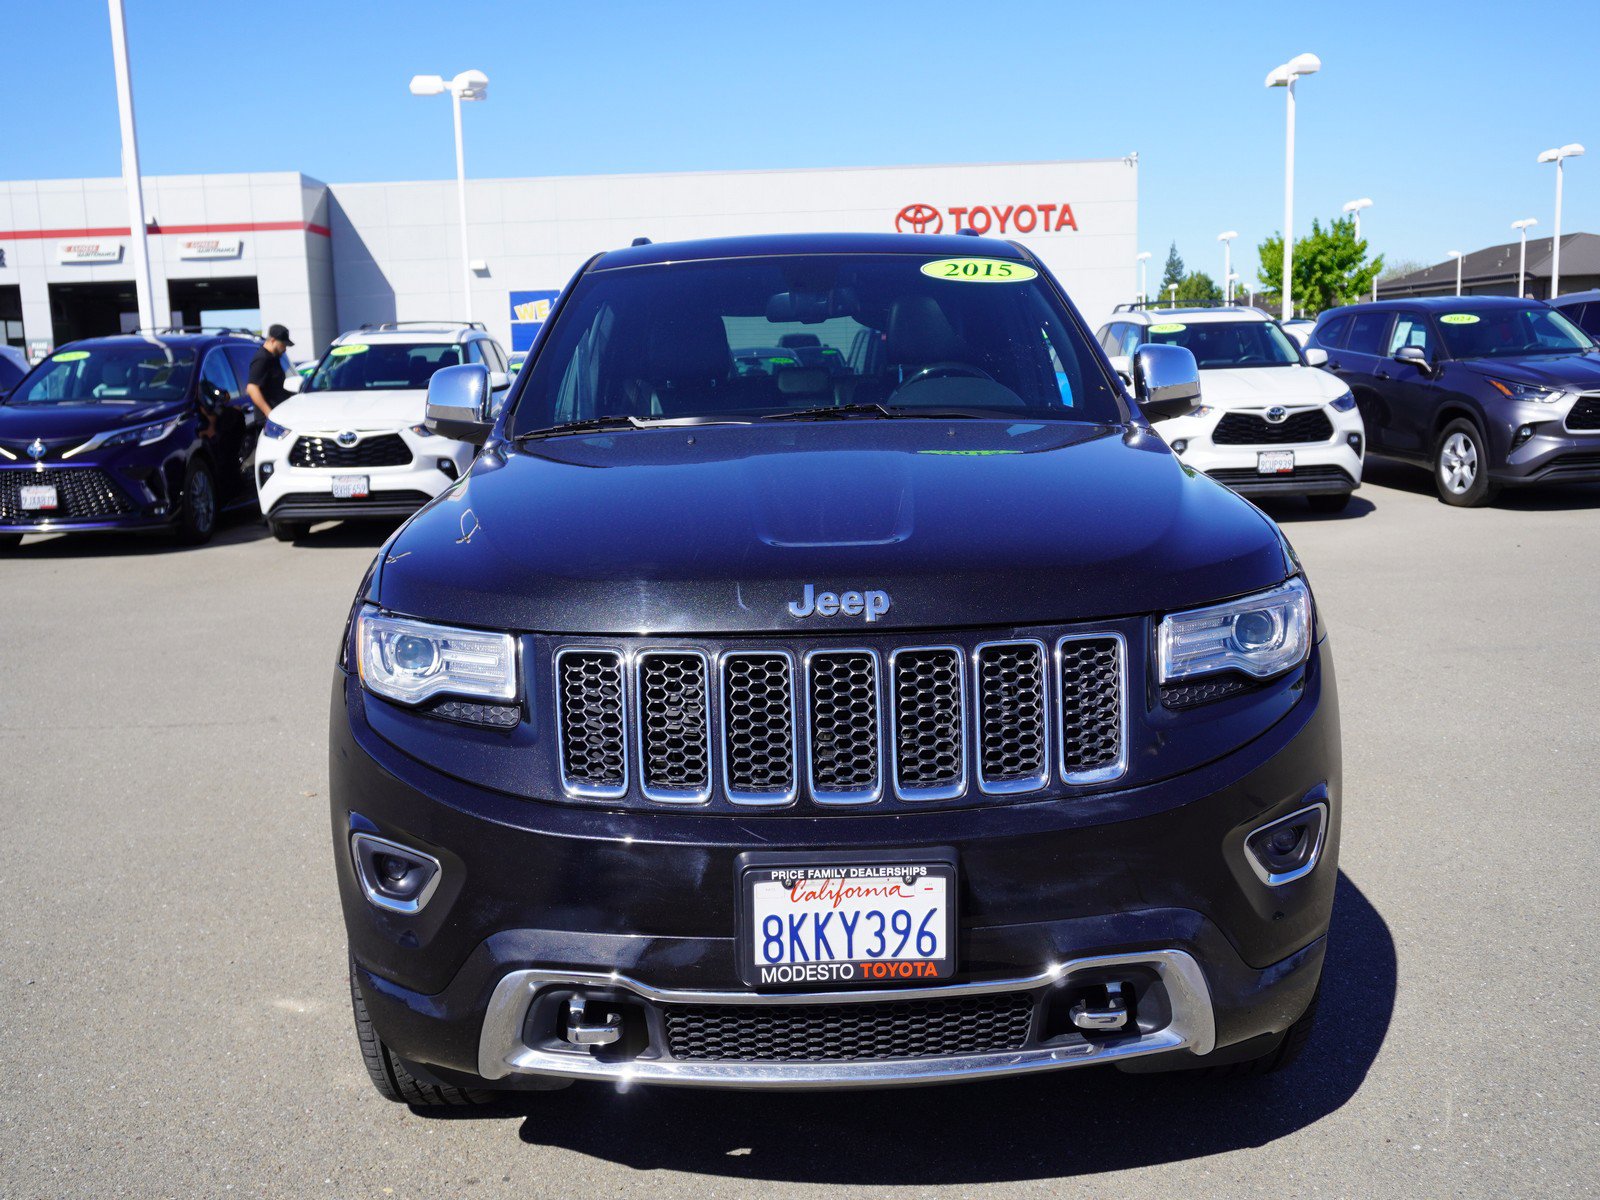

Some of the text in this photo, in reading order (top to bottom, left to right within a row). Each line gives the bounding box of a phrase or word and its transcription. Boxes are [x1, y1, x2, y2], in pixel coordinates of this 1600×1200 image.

[948, 203, 1078, 234] TOYOTA
[944, 263, 1012, 277] 2015
[513, 299, 550, 321] WE
[788, 583, 890, 623] Jeep
[771, 866, 928, 880] PRICE FAMILY DEALERSHIPS
[790, 879, 915, 908] California
[762, 907, 938, 964] 8KKY396
[761, 961, 938, 984] MODESTO TOYOTA
